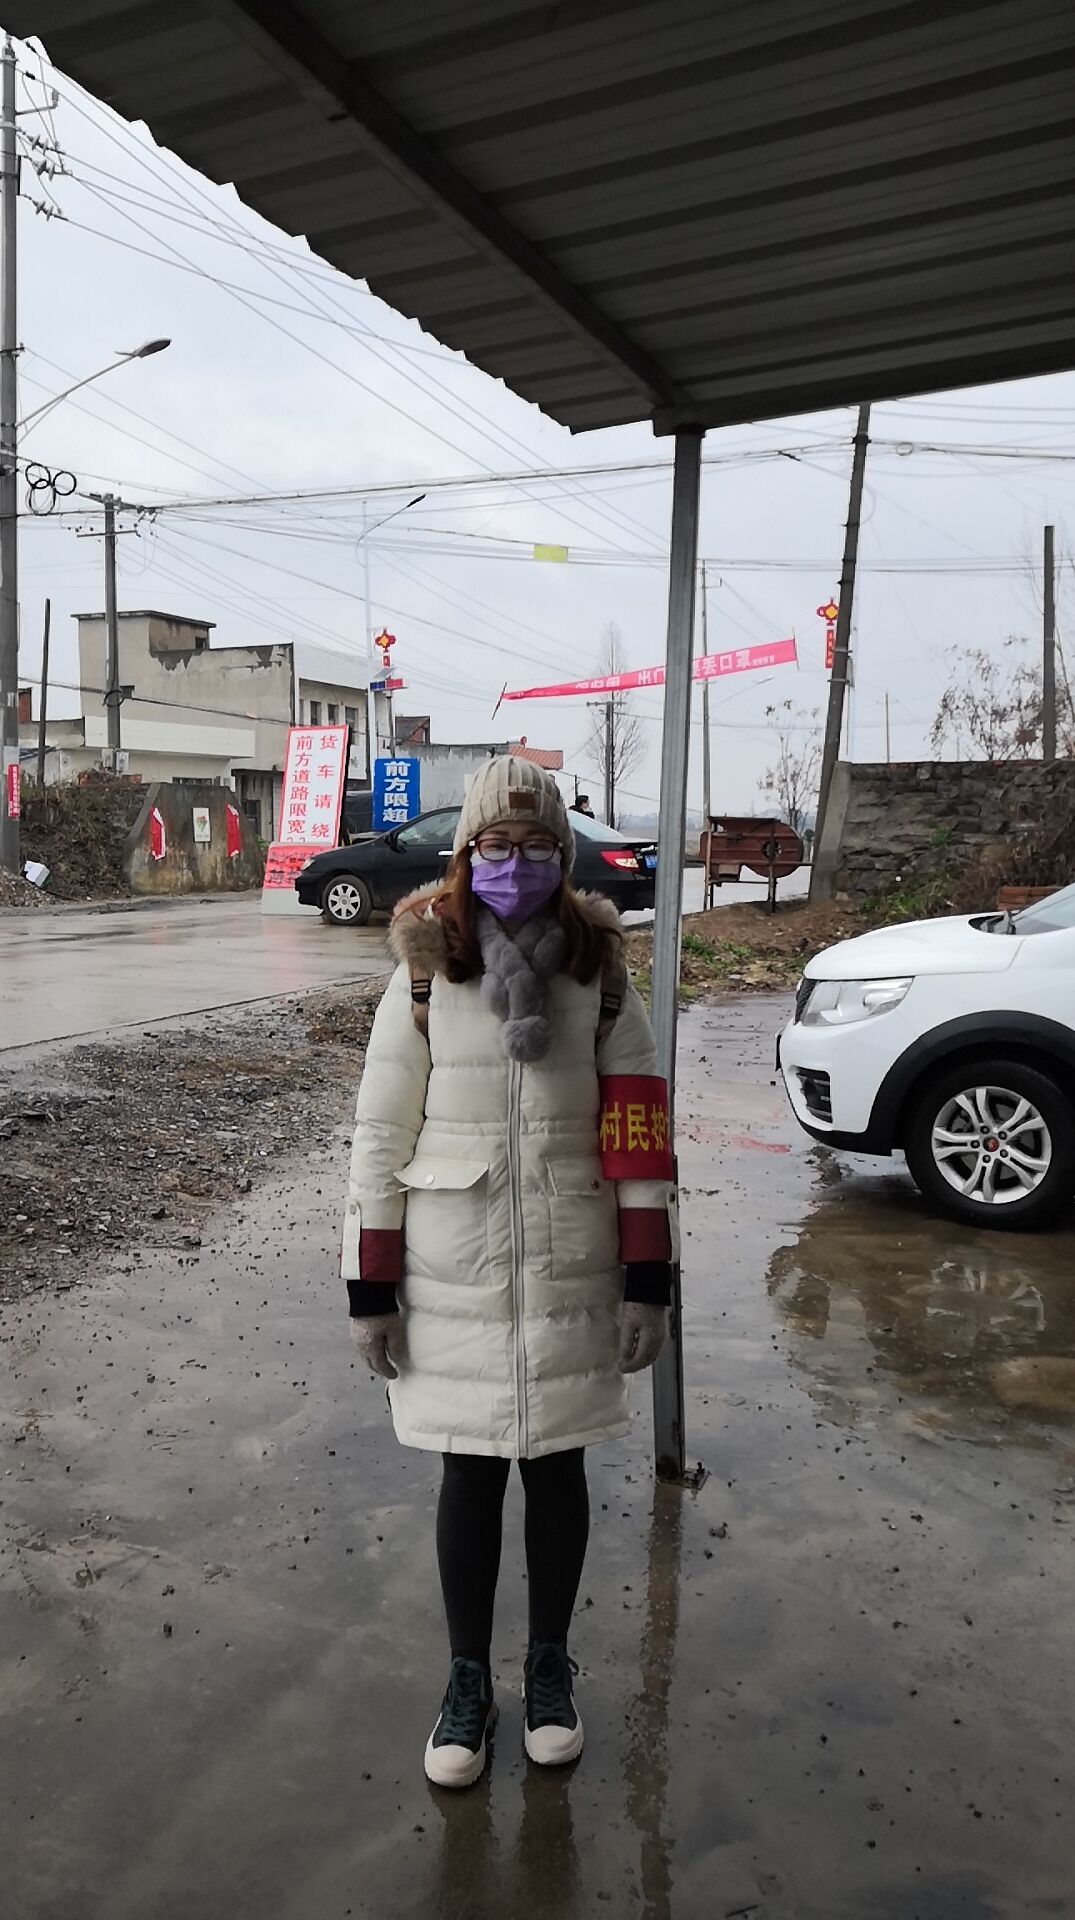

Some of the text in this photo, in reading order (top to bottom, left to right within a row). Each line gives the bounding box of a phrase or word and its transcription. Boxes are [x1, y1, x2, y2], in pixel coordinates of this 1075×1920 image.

[311, 735, 338, 838] 货车请绕
[382, 760, 411, 823] 前方限超
